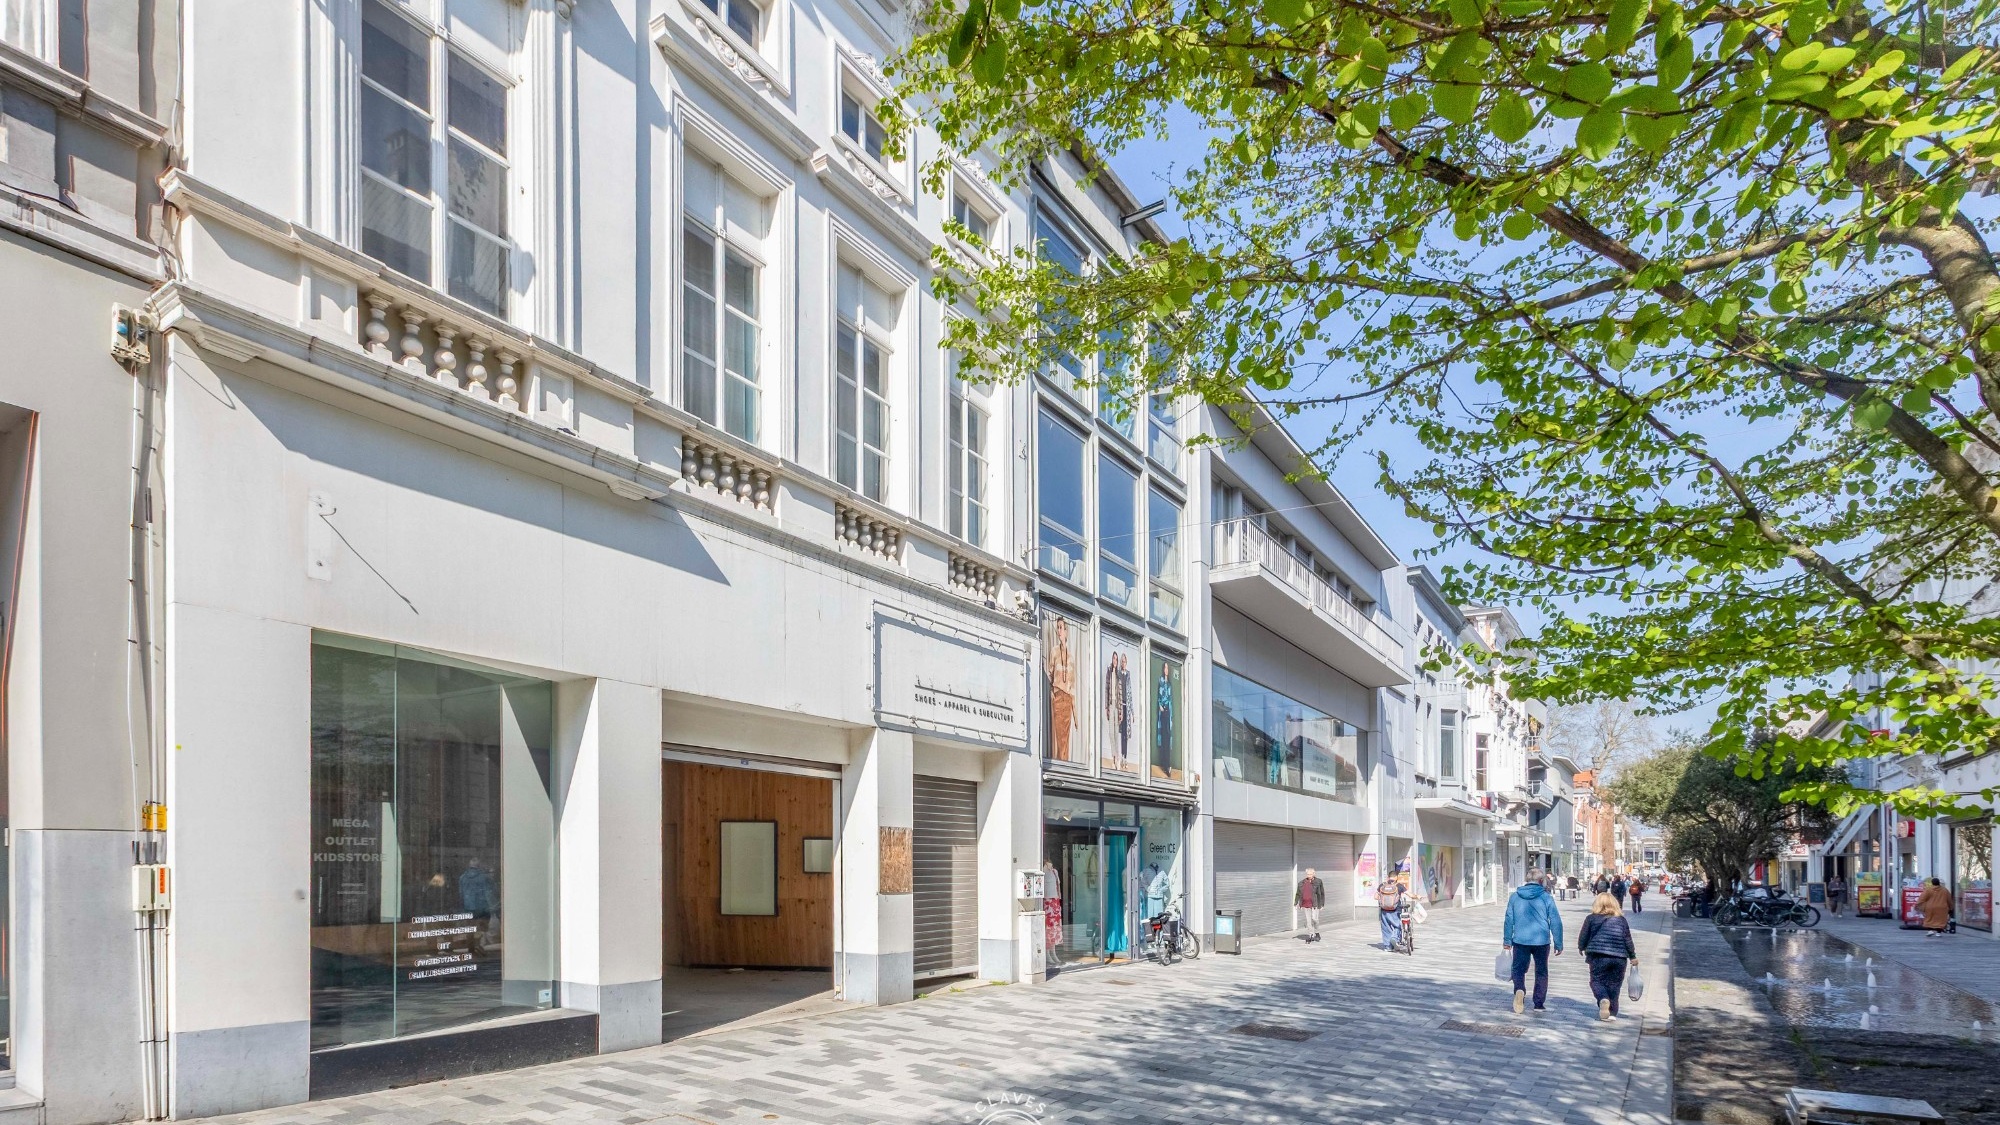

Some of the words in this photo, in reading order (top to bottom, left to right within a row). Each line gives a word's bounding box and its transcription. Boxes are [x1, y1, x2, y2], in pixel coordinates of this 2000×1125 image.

[915, 693, 936, 706] SHOES
[944, 701, 970, 714] APPAREL
[979, 708, 1014, 723] SUBCULTURE
[332, 818, 370, 828] MEGA
[325, 836, 377, 846] OUTLET
[1150, 842, 1166, 853] Green
[1167, 842, 1176, 854] ICE
[313, 853, 386, 862] KIDSSTORE
